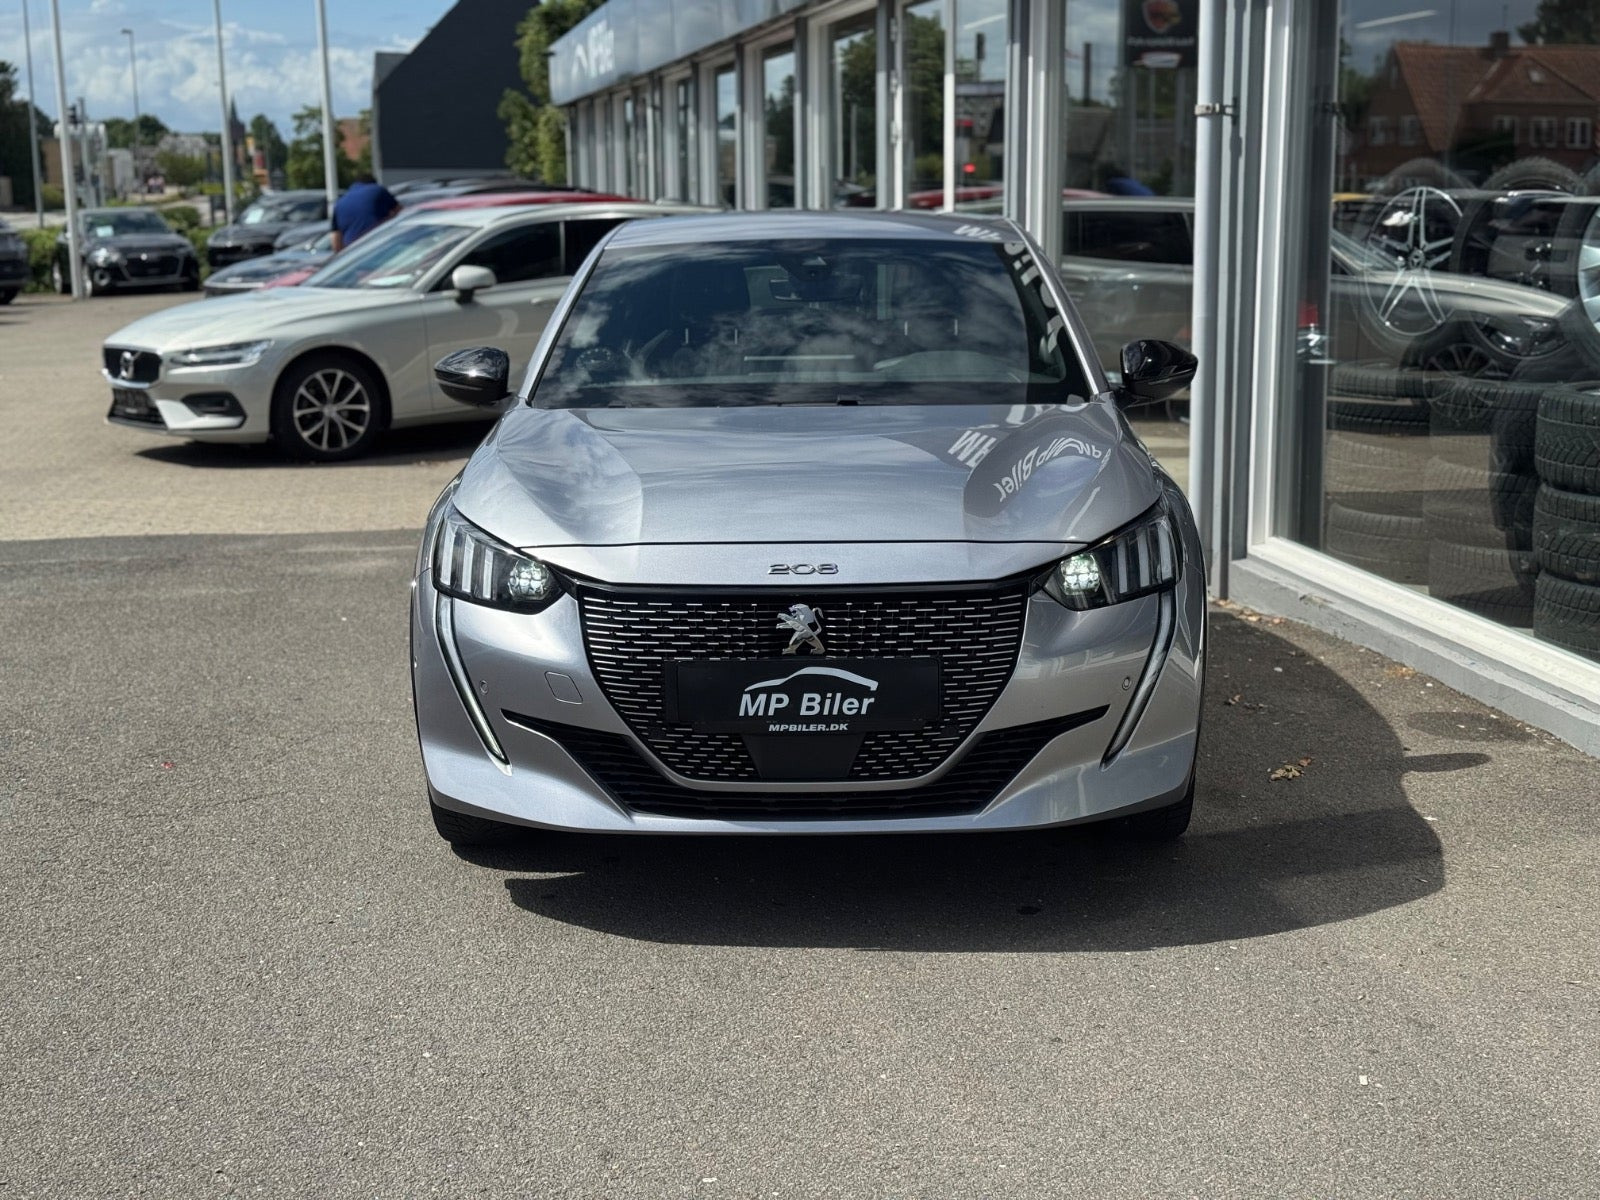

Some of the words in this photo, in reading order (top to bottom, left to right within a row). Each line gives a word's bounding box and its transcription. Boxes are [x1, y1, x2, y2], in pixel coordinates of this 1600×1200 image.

[768, 563, 839, 575] 208
[738, 693, 790, 717] MP
[800, 692, 875, 716] Biler
[768, 723, 849, 732] MPBILER.DK
